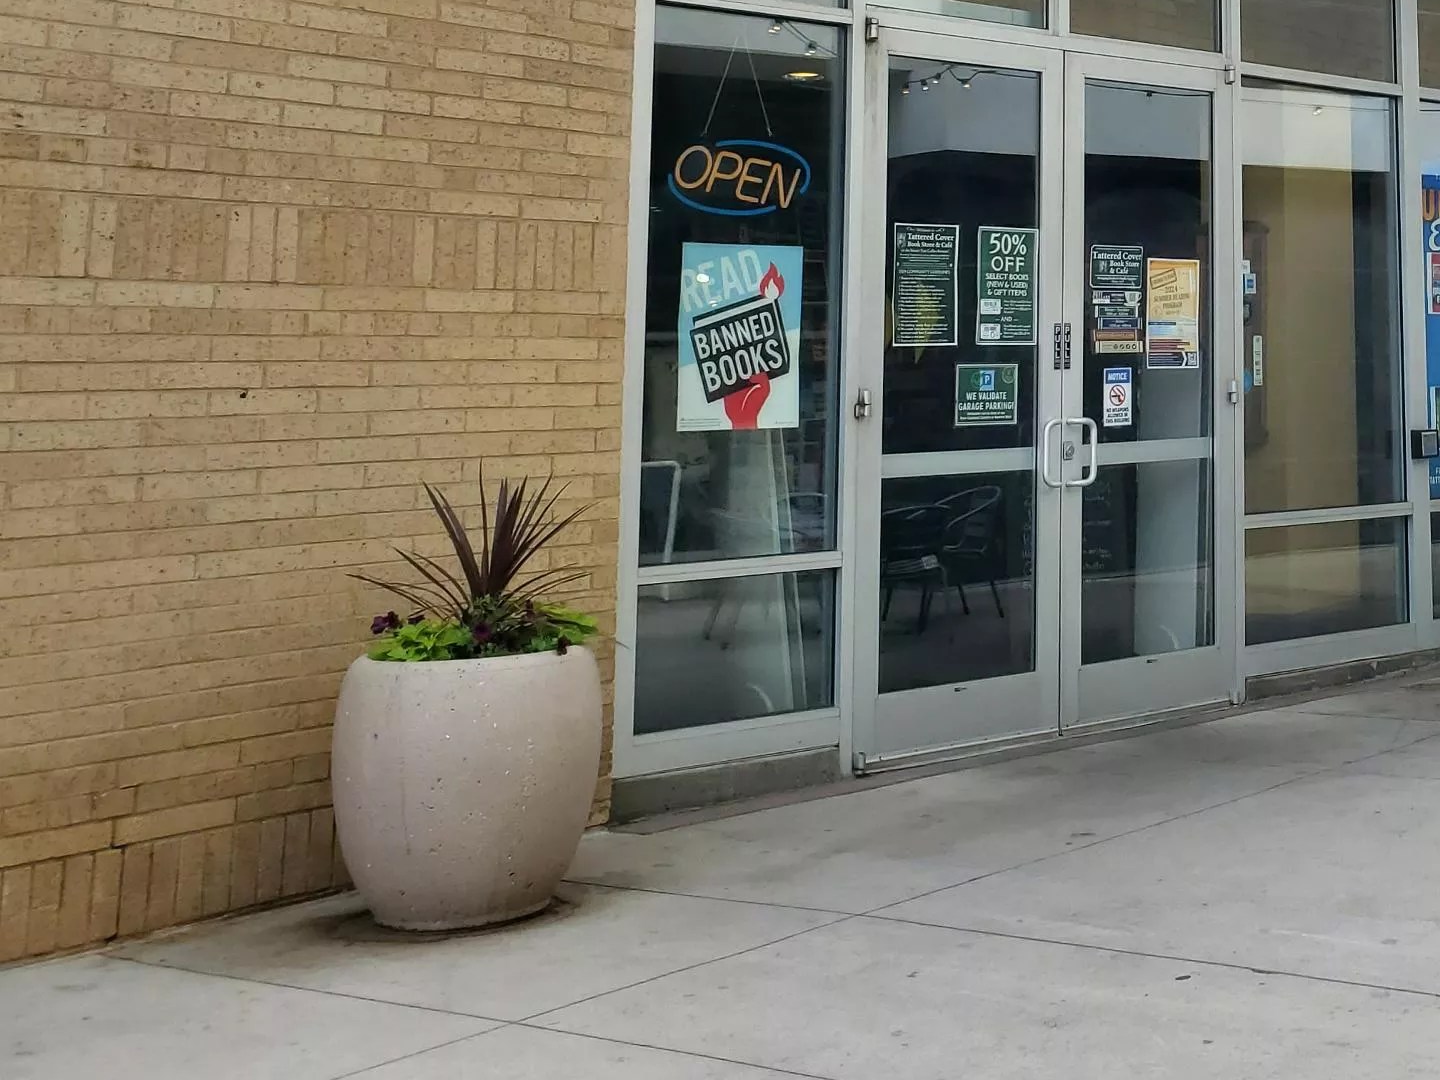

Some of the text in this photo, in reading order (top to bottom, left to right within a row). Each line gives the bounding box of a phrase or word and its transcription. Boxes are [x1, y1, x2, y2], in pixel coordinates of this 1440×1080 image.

[674, 145, 801, 209] OPEN
[907, 232, 955, 241] Tattered Cover
[989, 233, 1027, 255] 50%
[1093, 251, 1122, 260] Tattered
[991, 256, 1025, 272] OFF
[681, 249, 763, 313] READ
[694, 310, 776, 360] BANNED
[701, 339, 783, 393] BOOKS
[1107, 372, 1128, 381] NOTICE
[966, 391, 1007, 400] WE VALIDATE
[958, 402, 984, 410] GARAGE
